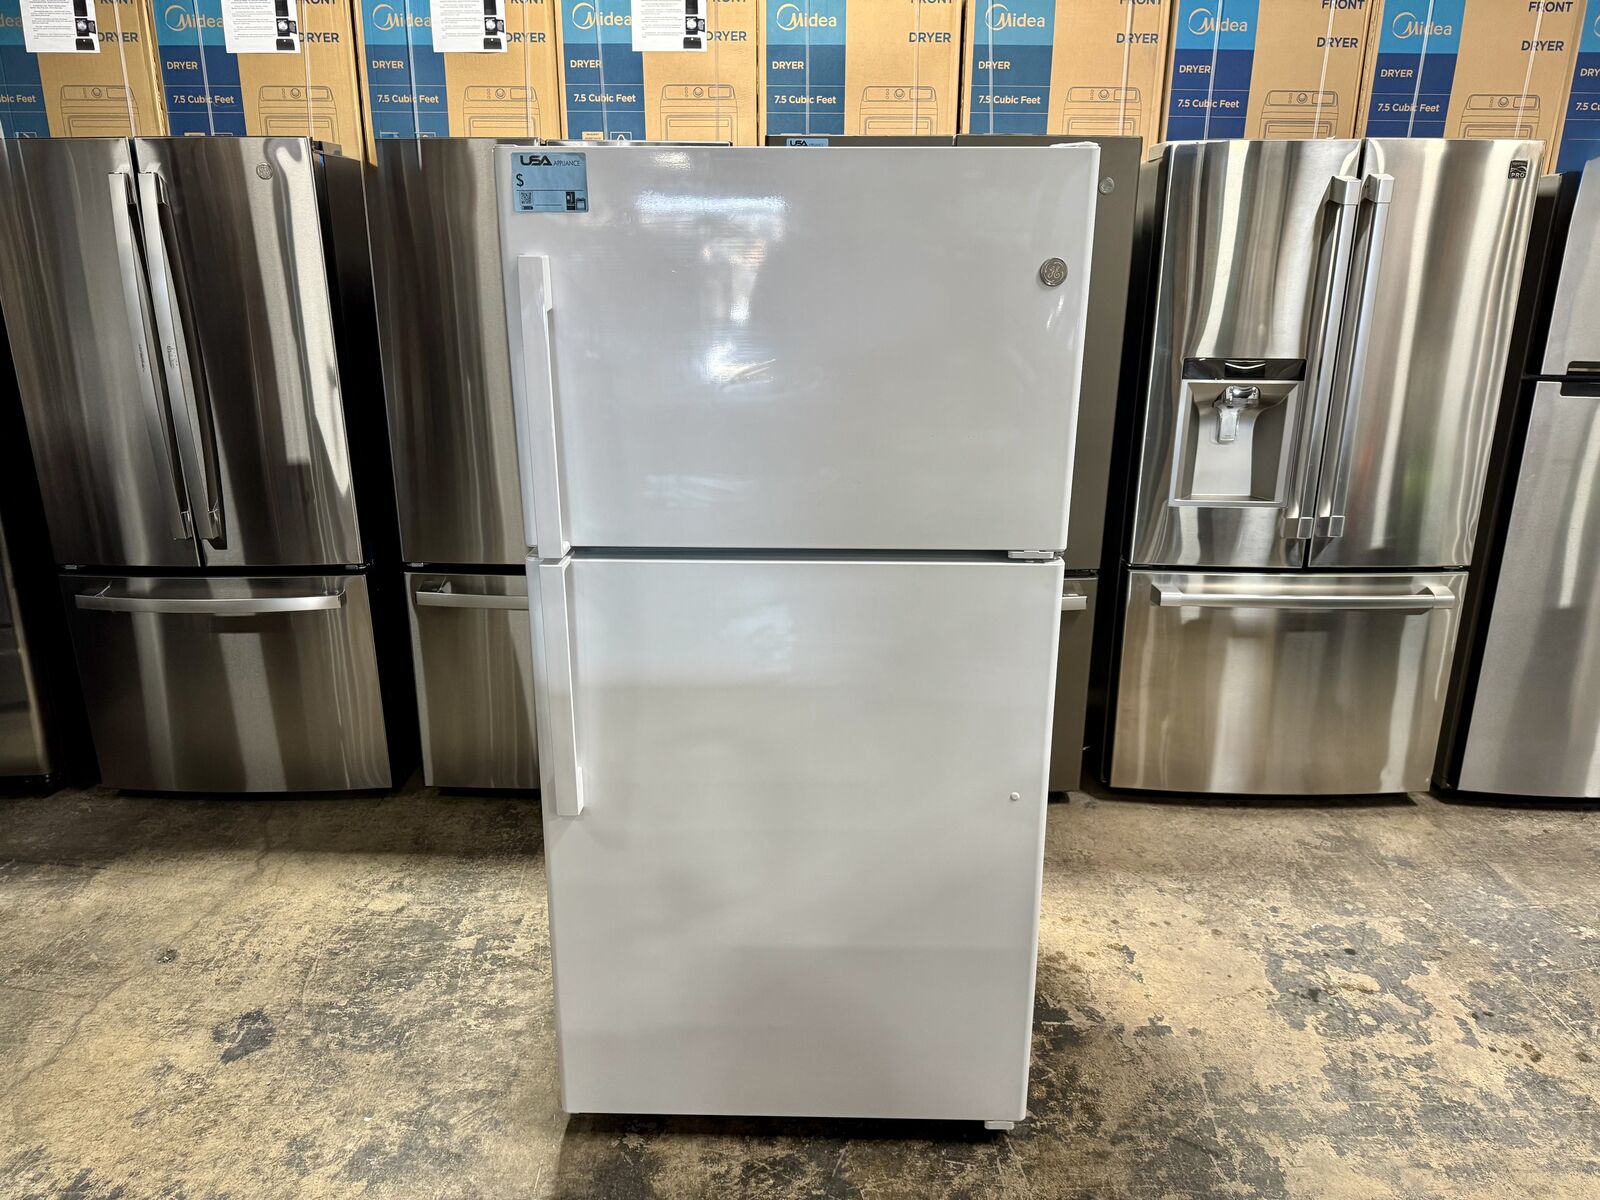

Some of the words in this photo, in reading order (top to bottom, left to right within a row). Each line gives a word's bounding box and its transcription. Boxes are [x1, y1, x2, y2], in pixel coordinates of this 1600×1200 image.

[373, 4, 432, 31] Midea
[776, 4, 837, 31] Midea
[985, 4, 1046, 31] Midea
[1188, 8, 1248, 35] Midea
[1392, 12, 1452, 39] Midea
[98, 32, 139, 42] DRYER
[298, 32, 340, 43] DRYER
[506, 32, 546, 43] DRYER
[706, 31, 747, 41] DRYER
[908, 32, 952, 43] DRYER
[1116, 33, 1159, 44] DRYER
[1316, 37, 1359, 48] DRYER
[1521, 40, 1565, 51] DRYER
[166, 61, 199, 70] DRYER
[372, 60, 404, 69] DRYER
[570, 60, 602, 68] DRYER
[772, 61, 805, 70] DRYER
[978, 61, 1011, 70] DRYER
[1179, 65, 1211, 74] DRYER
[1380, 69, 1414, 78] DRYER
[16, 94, 37, 103] Feet
[173, 95, 186, 104] 7.5
[187, 95, 213, 104] Cubic
[214, 95, 235, 104] Feet
[377, 95, 390, 103] 7.5
[419, 95, 440, 104] Feet
[573, 93, 587, 102] 7.5
[588, 93, 614, 103] Cubic
[615, 93, 637, 103] Feet
[774, 95, 787, 104] 7.5
[788, 95, 815, 104] Cubic
[816, 95, 837, 104] Feet
[978, 95, 991, 104] 7.5
[993, 95, 1019, 104] Cubic
[1020, 96, 1041, 104] Feet
[1178, 99, 1190, 108] 7.5
[1192, 99, 1218, 108] Cubic
[1219, 100, 1240, 108] Feet
[1377, 103, 1390, 112] 7.5
[1392, 103, 1418, 112] Cubic
[1419, 104, 1440, 112] Feet
[1576, 102, 1589, 111] 7.5
[520, 155, 553, 166] USA
[516, 173, 525, 187] $
